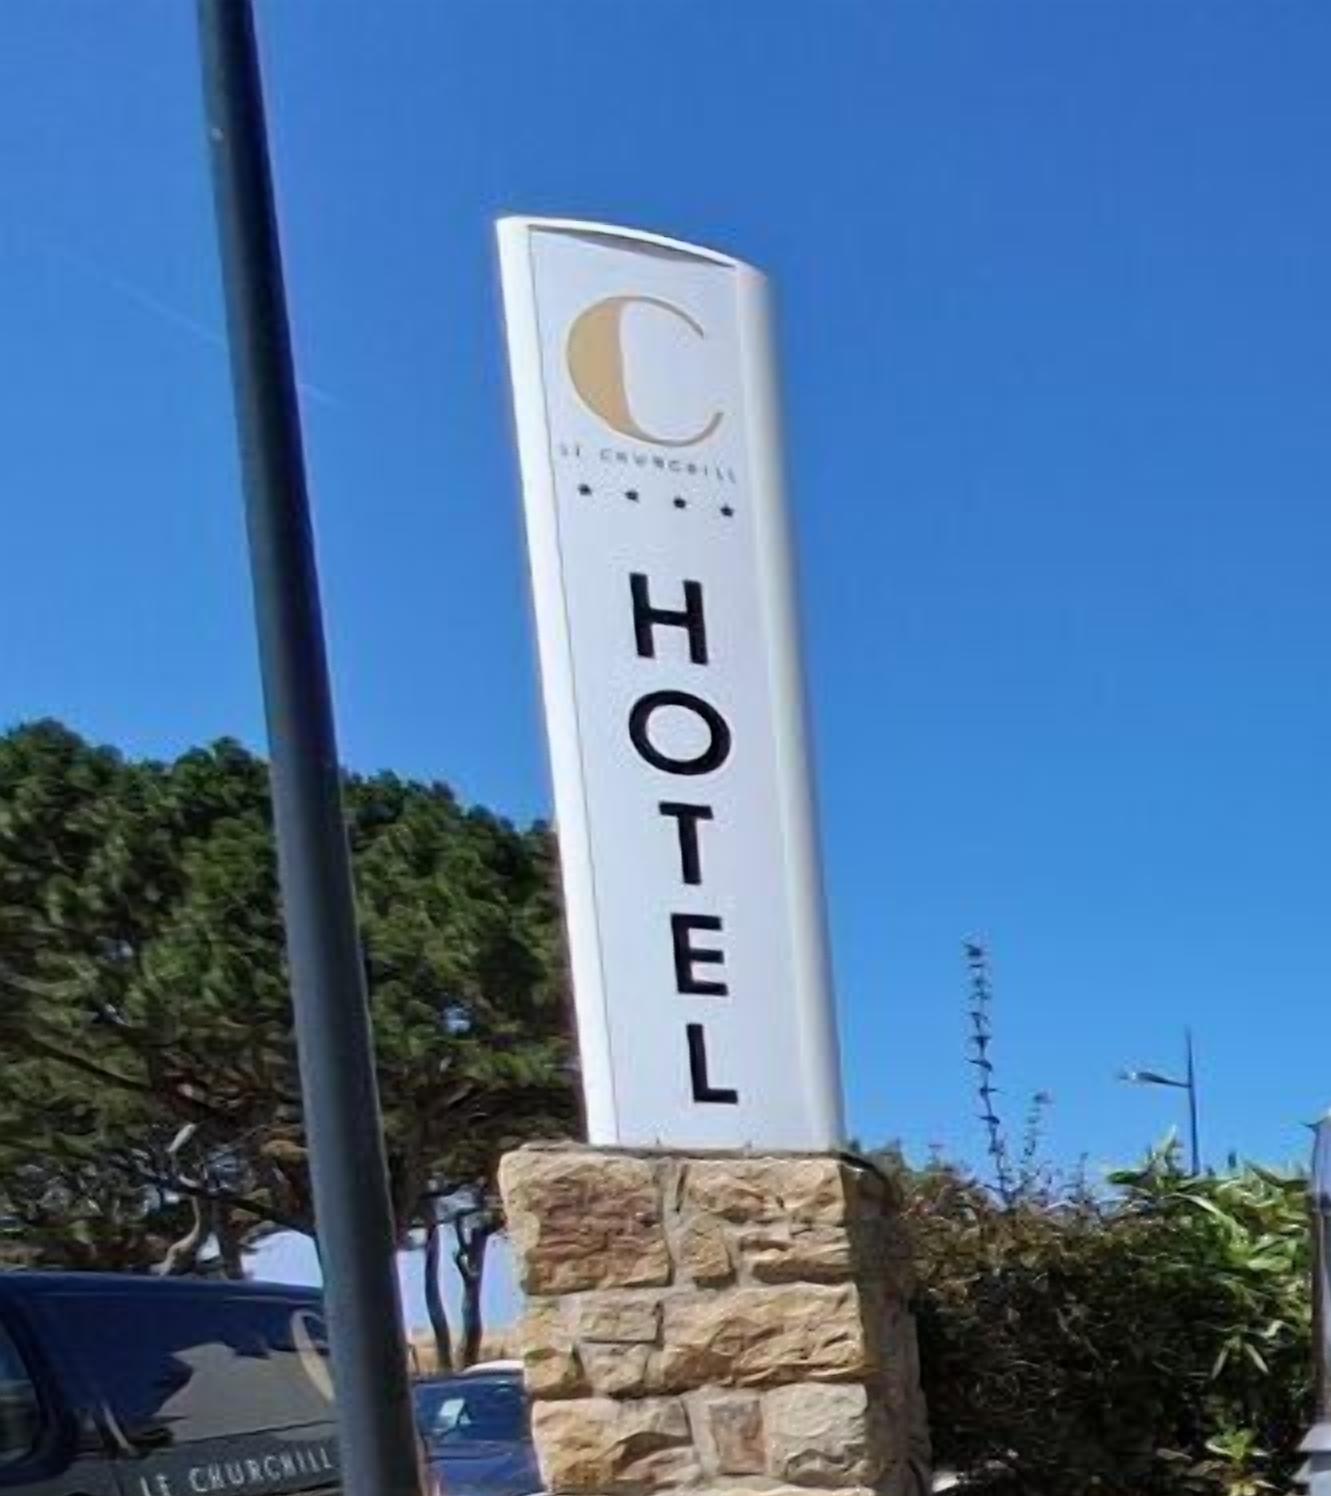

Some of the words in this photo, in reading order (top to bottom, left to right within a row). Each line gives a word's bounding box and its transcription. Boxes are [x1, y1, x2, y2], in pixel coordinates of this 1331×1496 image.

[568, 296, 724, 446] C
[628, 572, 738, 1104] HOTEL
[188, 1447, 333, 1492] CHURCHILL
